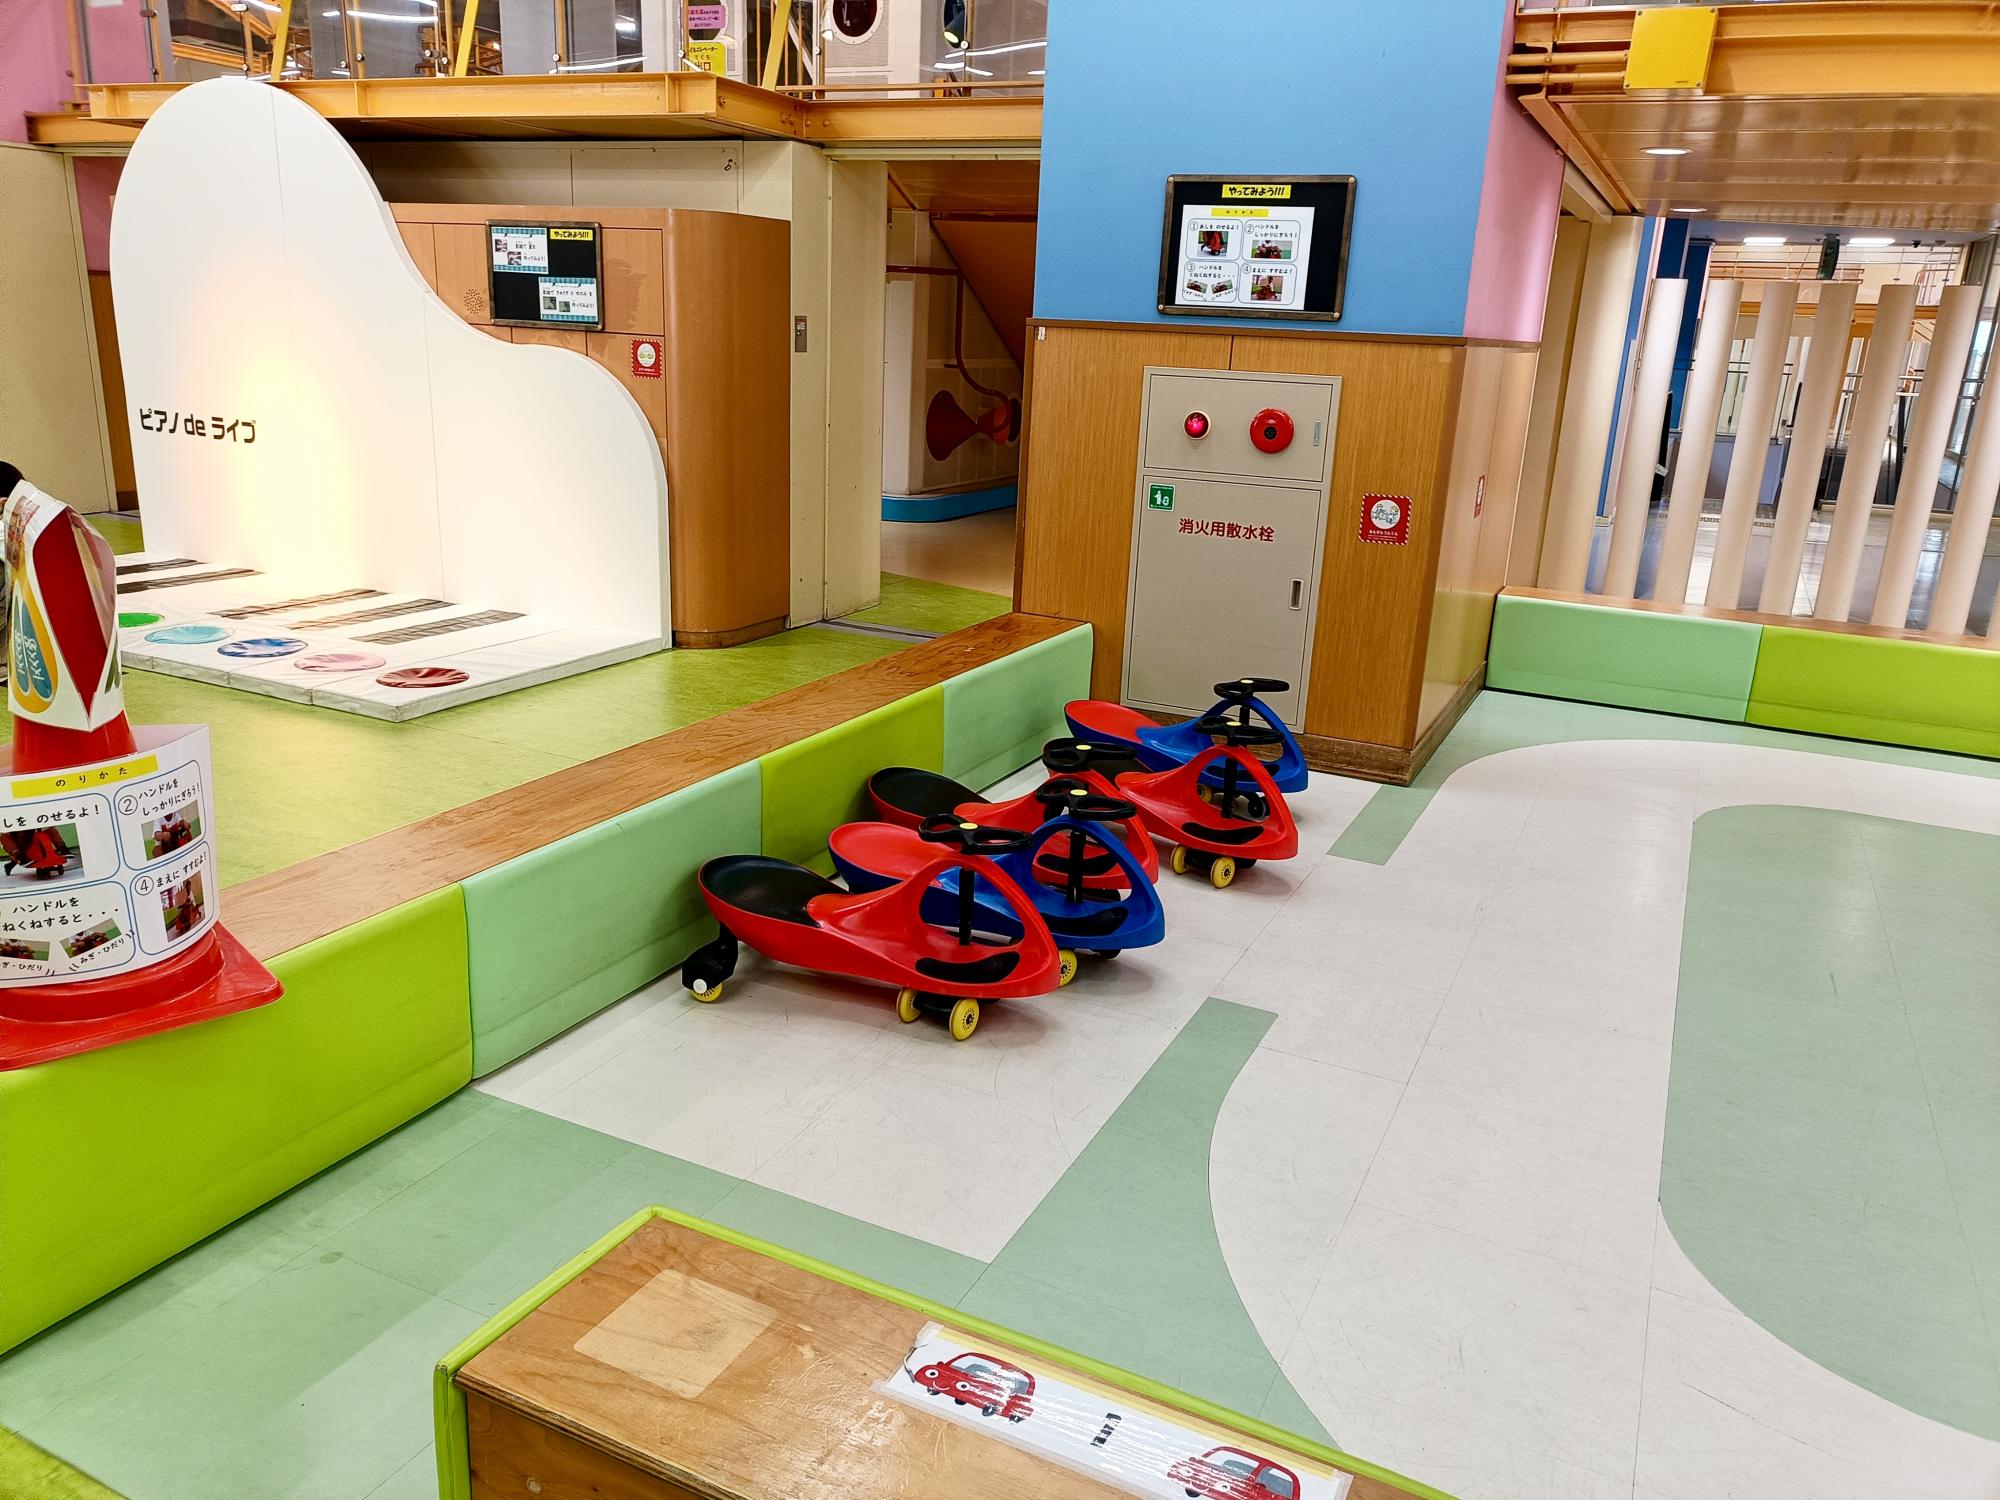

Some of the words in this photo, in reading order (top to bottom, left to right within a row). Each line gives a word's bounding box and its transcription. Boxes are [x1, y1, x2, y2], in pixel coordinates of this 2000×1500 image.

[1228, 186, 1285, 197] やってみよう!!!
[139, 408, 179, 434] ピアノ
[184, 413, 206, 437] de
[211, 416, 256, 444] ライブ
[1178, 517, 1275, 542] 消火用散水栓
[55, 766, 128, 788] のりかた
[138, 778, 179, 800] ハンドルを
[142, 781, 201, 816] しっかりにぎろう！
[37, 804, 100, 824] のせるよ！
[155, 870, 180, 888] まえに
[12, 896, 80, 915] ハンドルを
